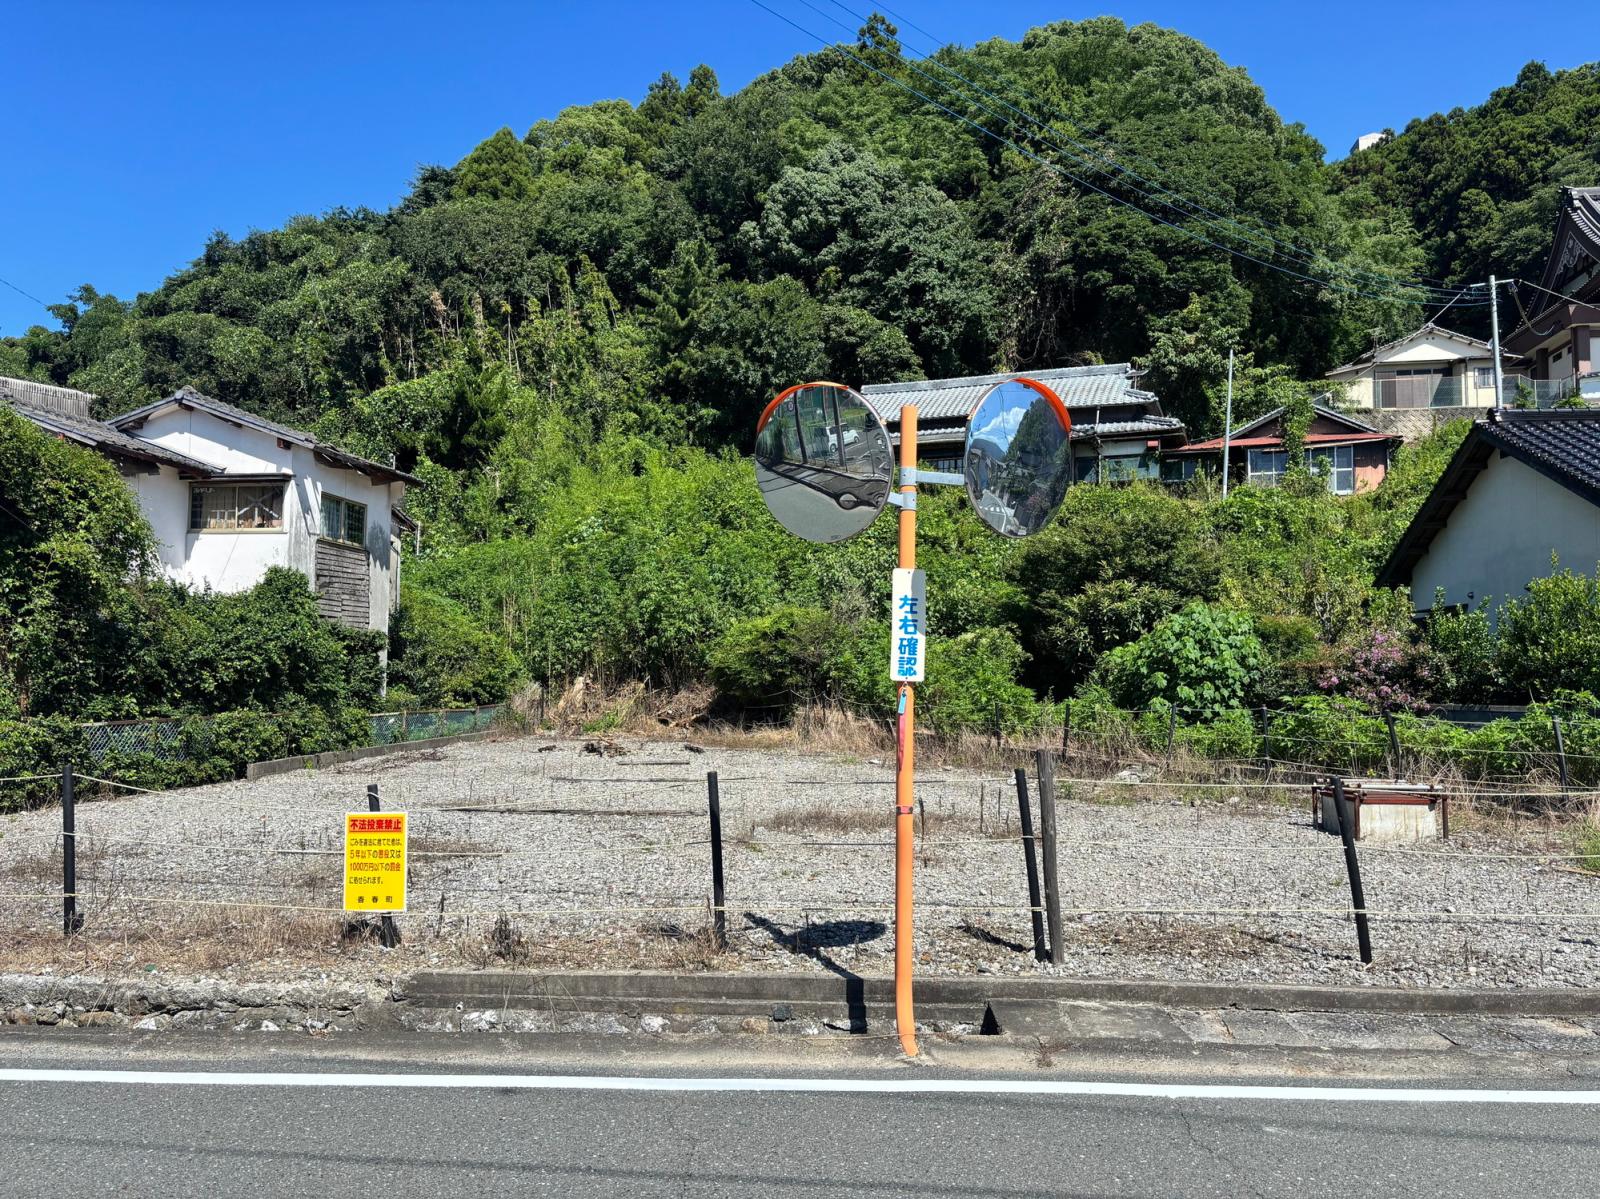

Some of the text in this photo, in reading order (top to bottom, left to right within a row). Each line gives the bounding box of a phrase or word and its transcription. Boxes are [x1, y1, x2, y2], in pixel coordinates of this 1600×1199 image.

[898, 594, 919, 676] 左右確認
[350, 819, 401, 830] 不法投棄禁止
